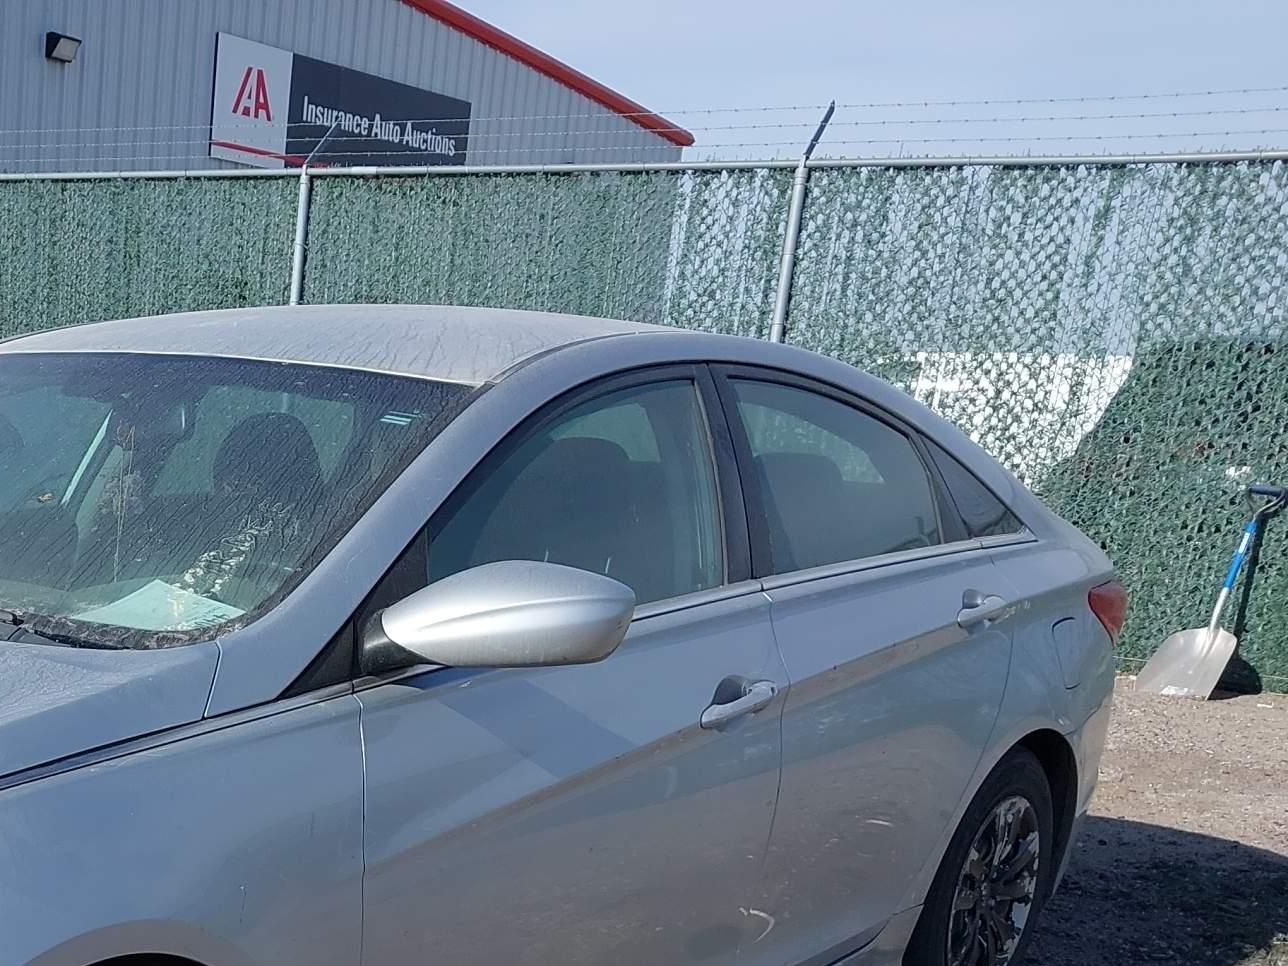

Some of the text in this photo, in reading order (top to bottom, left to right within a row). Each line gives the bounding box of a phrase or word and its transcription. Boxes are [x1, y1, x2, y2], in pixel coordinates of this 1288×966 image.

[303, 96, 456, 156] Insurance Auto Auctions
